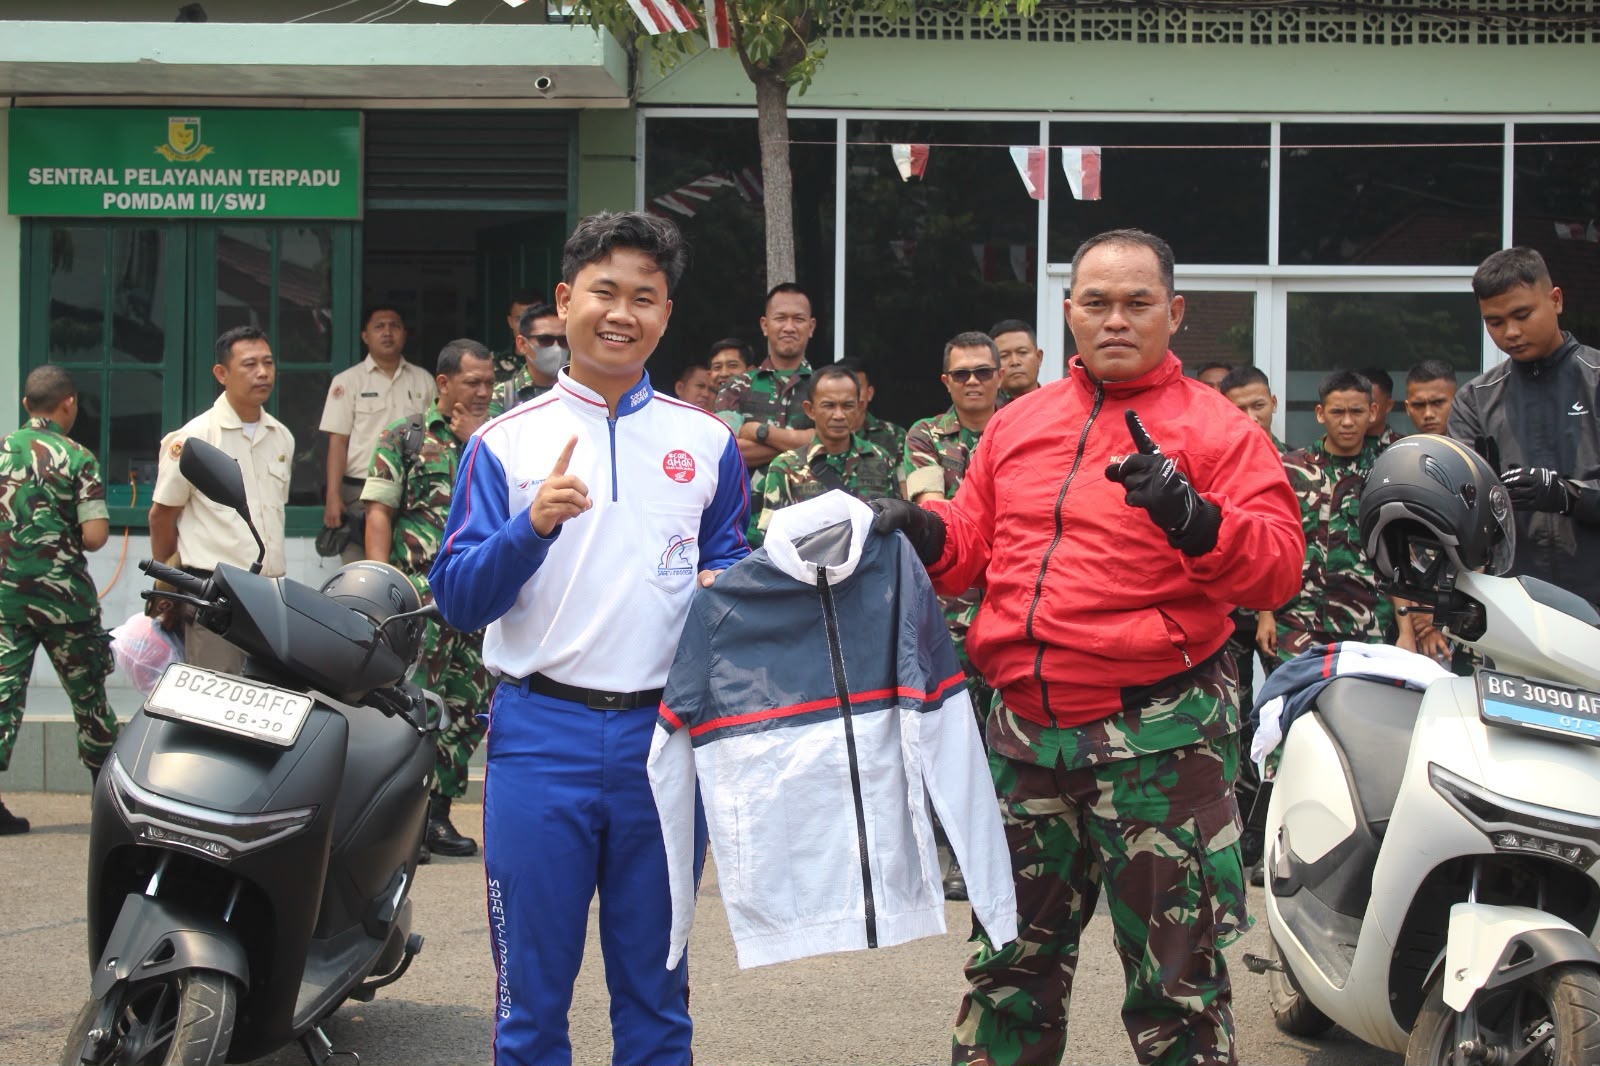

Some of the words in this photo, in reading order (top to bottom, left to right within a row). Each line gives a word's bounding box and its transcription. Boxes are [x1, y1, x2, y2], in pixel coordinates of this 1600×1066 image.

[28, 168, 119, 186] SENTRAL
[125, 168, 242, 186] PELAYANAN
[248, 169, 341, 187] TERPADU
[103, 192, 194, 211] POMDAM
[200, 193, 266, 213] II/SWJ
[174, 670, 298, 716] BG2209AFC
[1488, 676, 1516, 698] BG
[1521, 683, 1574, 709] 3090
[1538, 819, 1570, 832] HONDA
